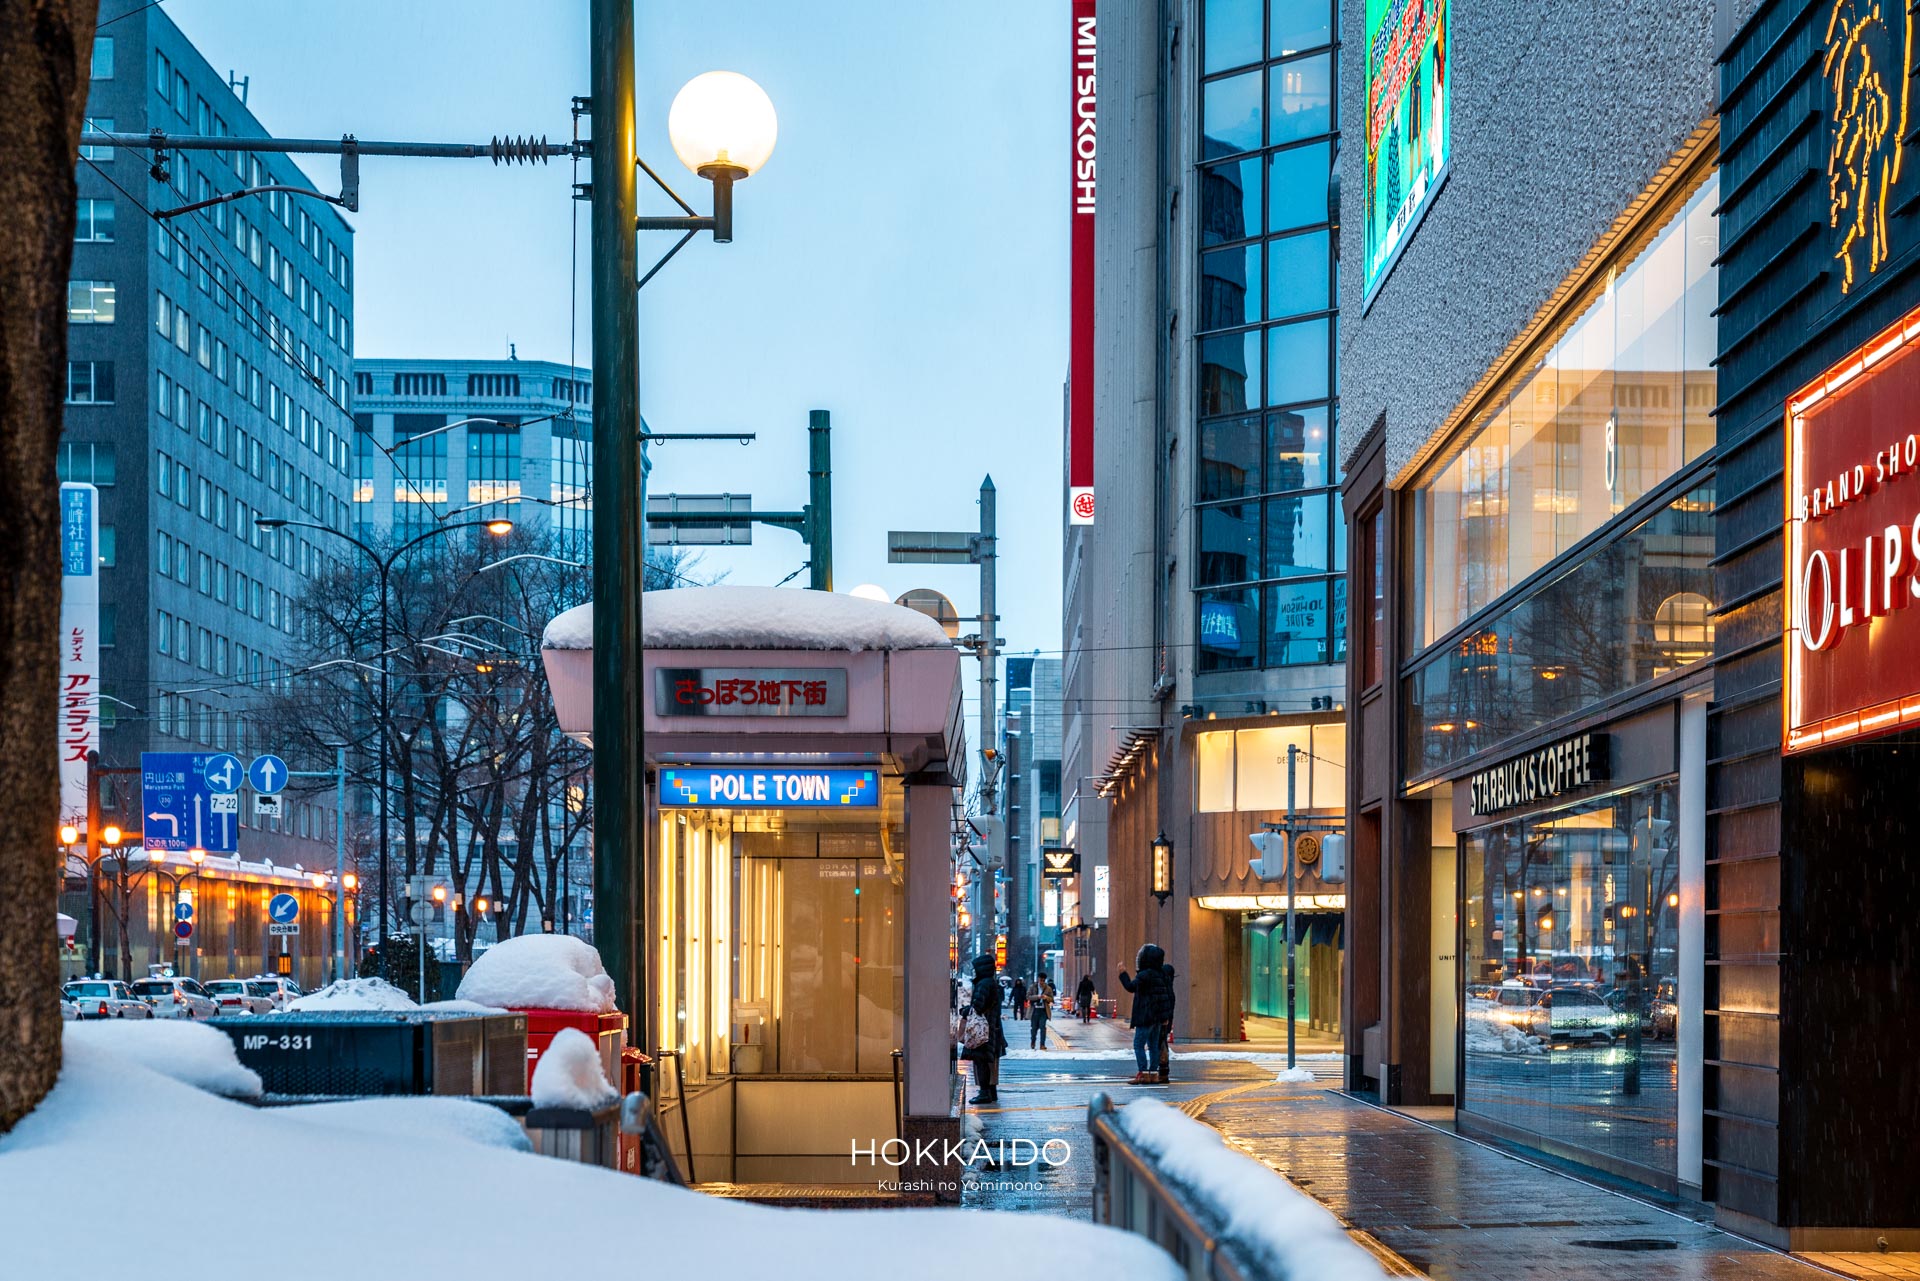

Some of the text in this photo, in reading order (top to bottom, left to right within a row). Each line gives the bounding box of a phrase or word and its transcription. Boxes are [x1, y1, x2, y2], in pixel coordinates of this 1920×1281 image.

[1077, 17, 1097, 214] MITSUKOSHI
[1802, 464, 1864, 523] BRAND
[68, 491, 86, 574] 書峰社書道
[71, 627, 85, 662] レディス
[675, 679, 827, 705] さっぽろ地下街
[64, 674, 91, 762] アデランス
[145, 772, 185, 783] 円山公園
[711, 774, 830, 801] POLE TOWN
[1470, 733, 1590, 816] STARBUCKS COFFEE
[213, 799, 236, 809] 7-22
[244, 1035, 312, 1050] MP-331
